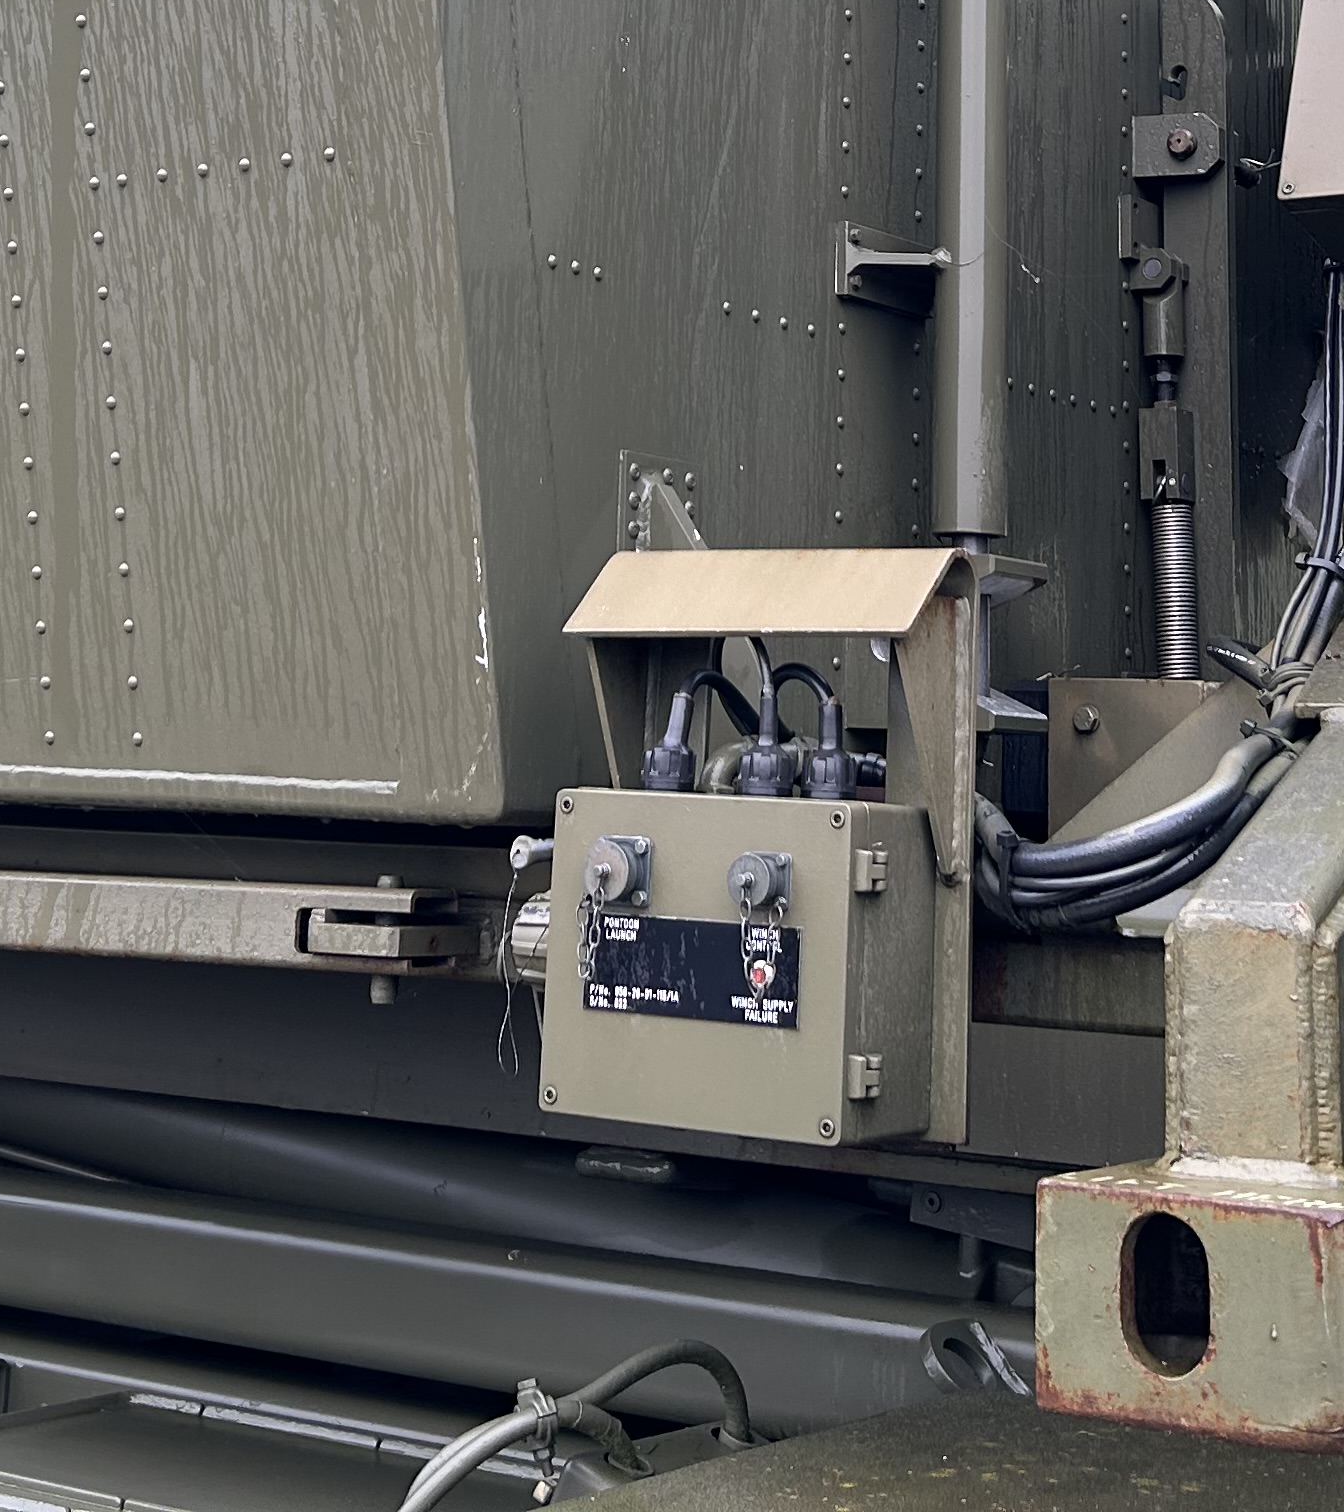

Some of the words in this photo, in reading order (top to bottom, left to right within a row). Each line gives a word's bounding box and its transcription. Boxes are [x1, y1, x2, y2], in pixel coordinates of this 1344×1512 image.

[604, 916, 640, 930] PONTOON
[605, 928, 637, 942] LAUNCH
[762, 998, 794, 1013] SUPPLY
[744, 1009, 779, 1024] FAILURE
